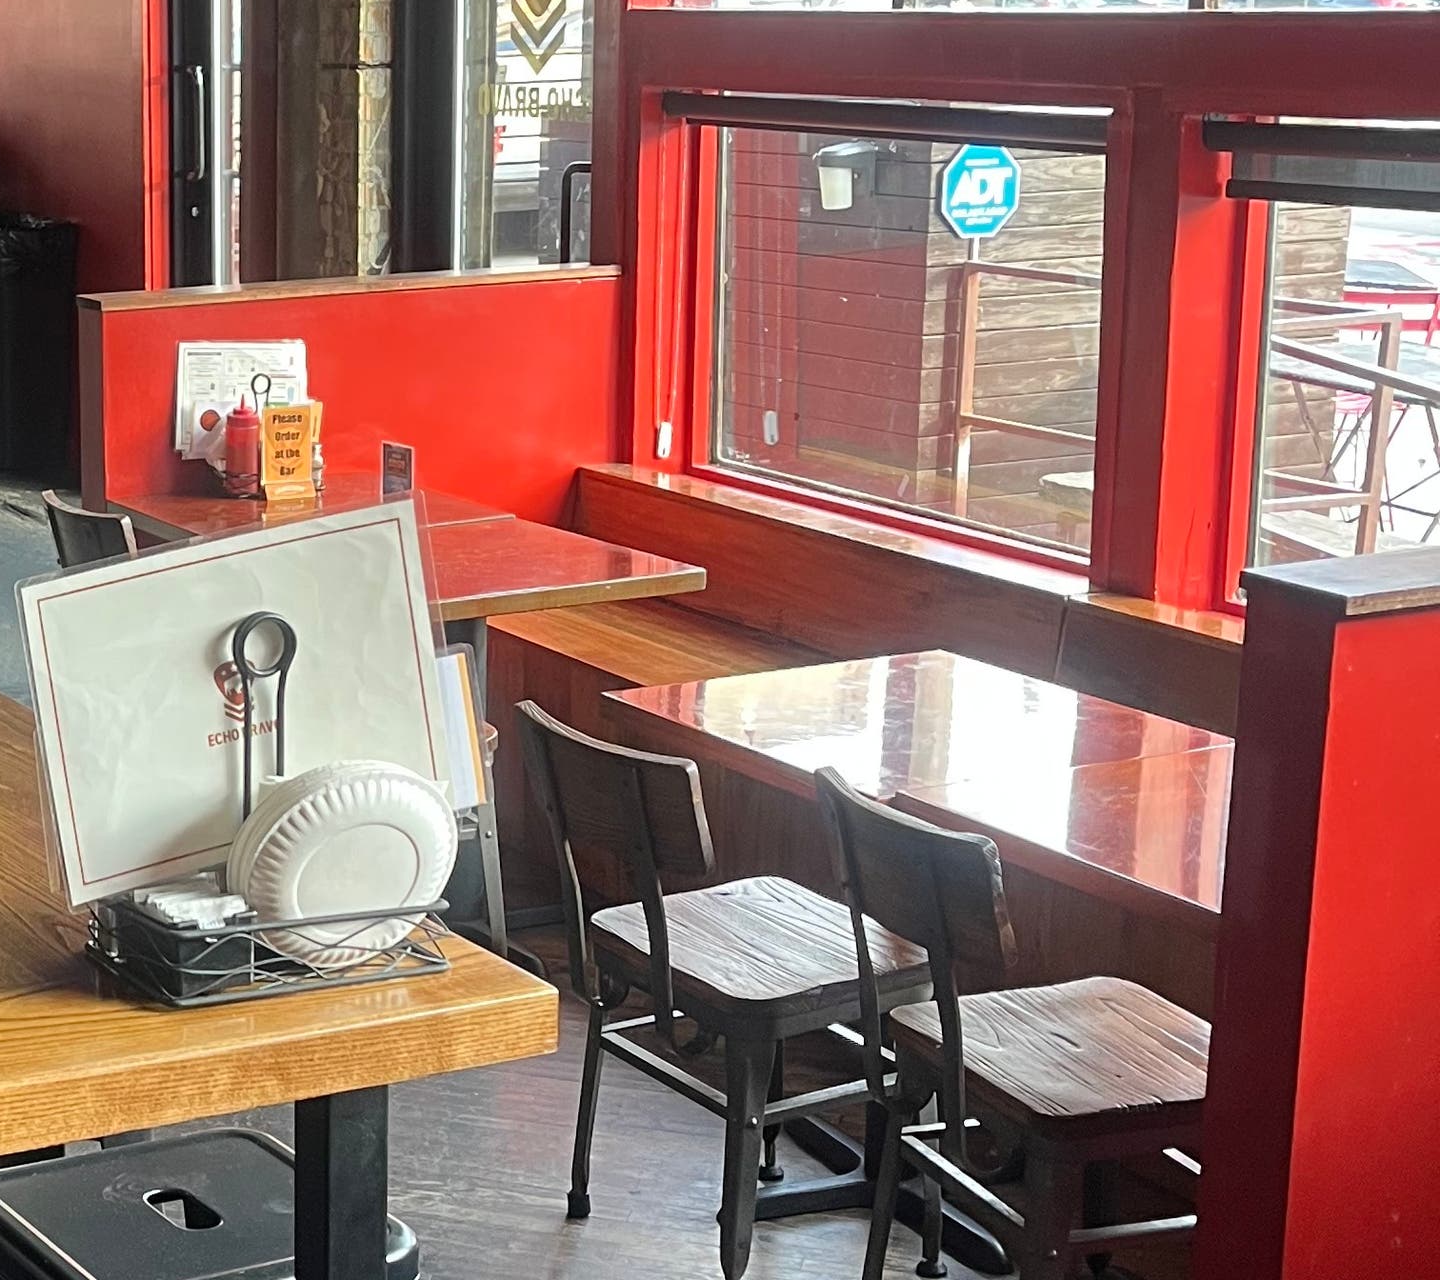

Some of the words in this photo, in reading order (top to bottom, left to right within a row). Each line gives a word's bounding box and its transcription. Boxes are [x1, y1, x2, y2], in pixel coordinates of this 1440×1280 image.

[949, 166, 1013, 207] ADT
[272, 414, 303, 425] Please
[274, 431, 301, 442] Order
[207, 728, 240, 747] ECHO
